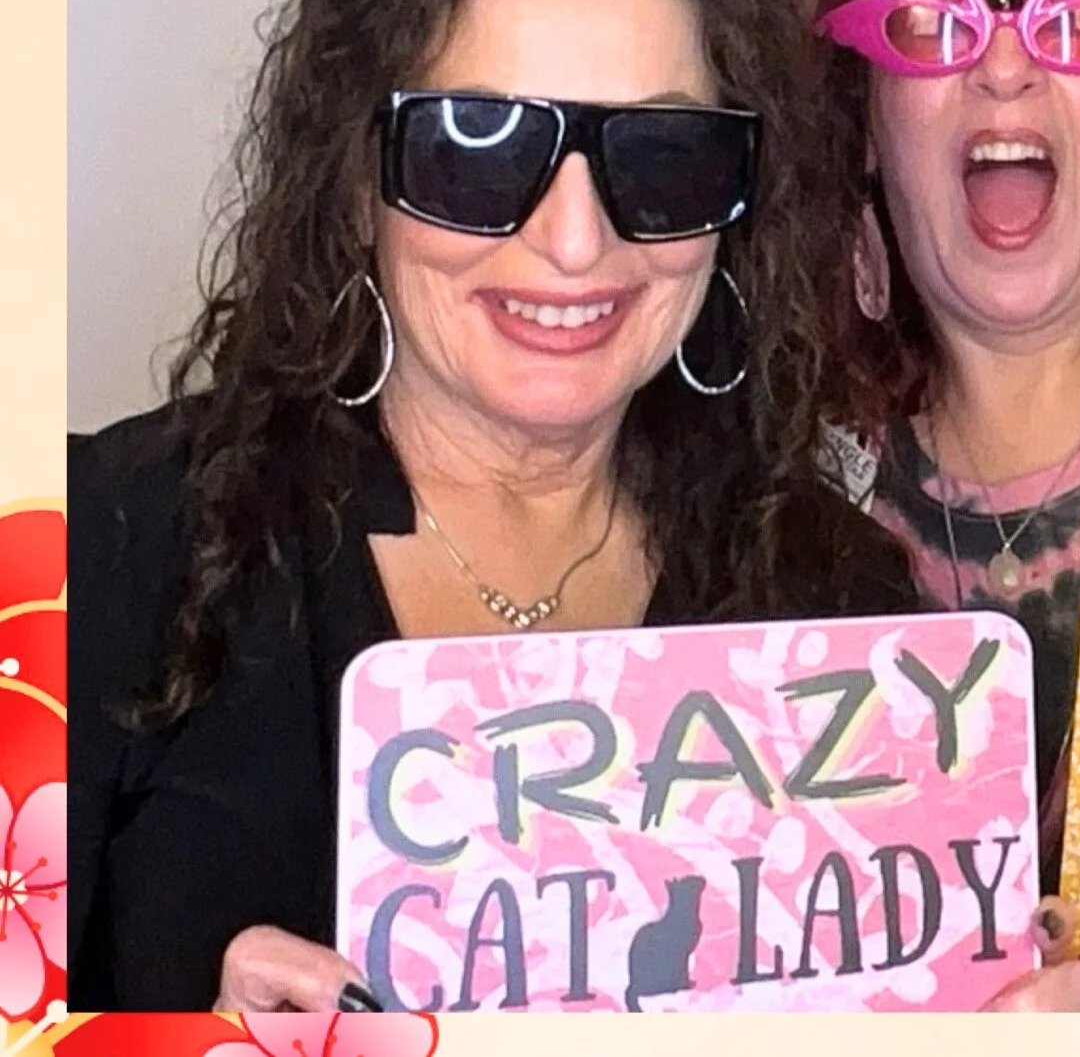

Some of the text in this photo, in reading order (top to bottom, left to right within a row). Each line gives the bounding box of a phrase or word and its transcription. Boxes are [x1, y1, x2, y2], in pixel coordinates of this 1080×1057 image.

[367, 638, 1001, 866] CRAZY
[365, 836, 1021, 1012] CAT LADY
